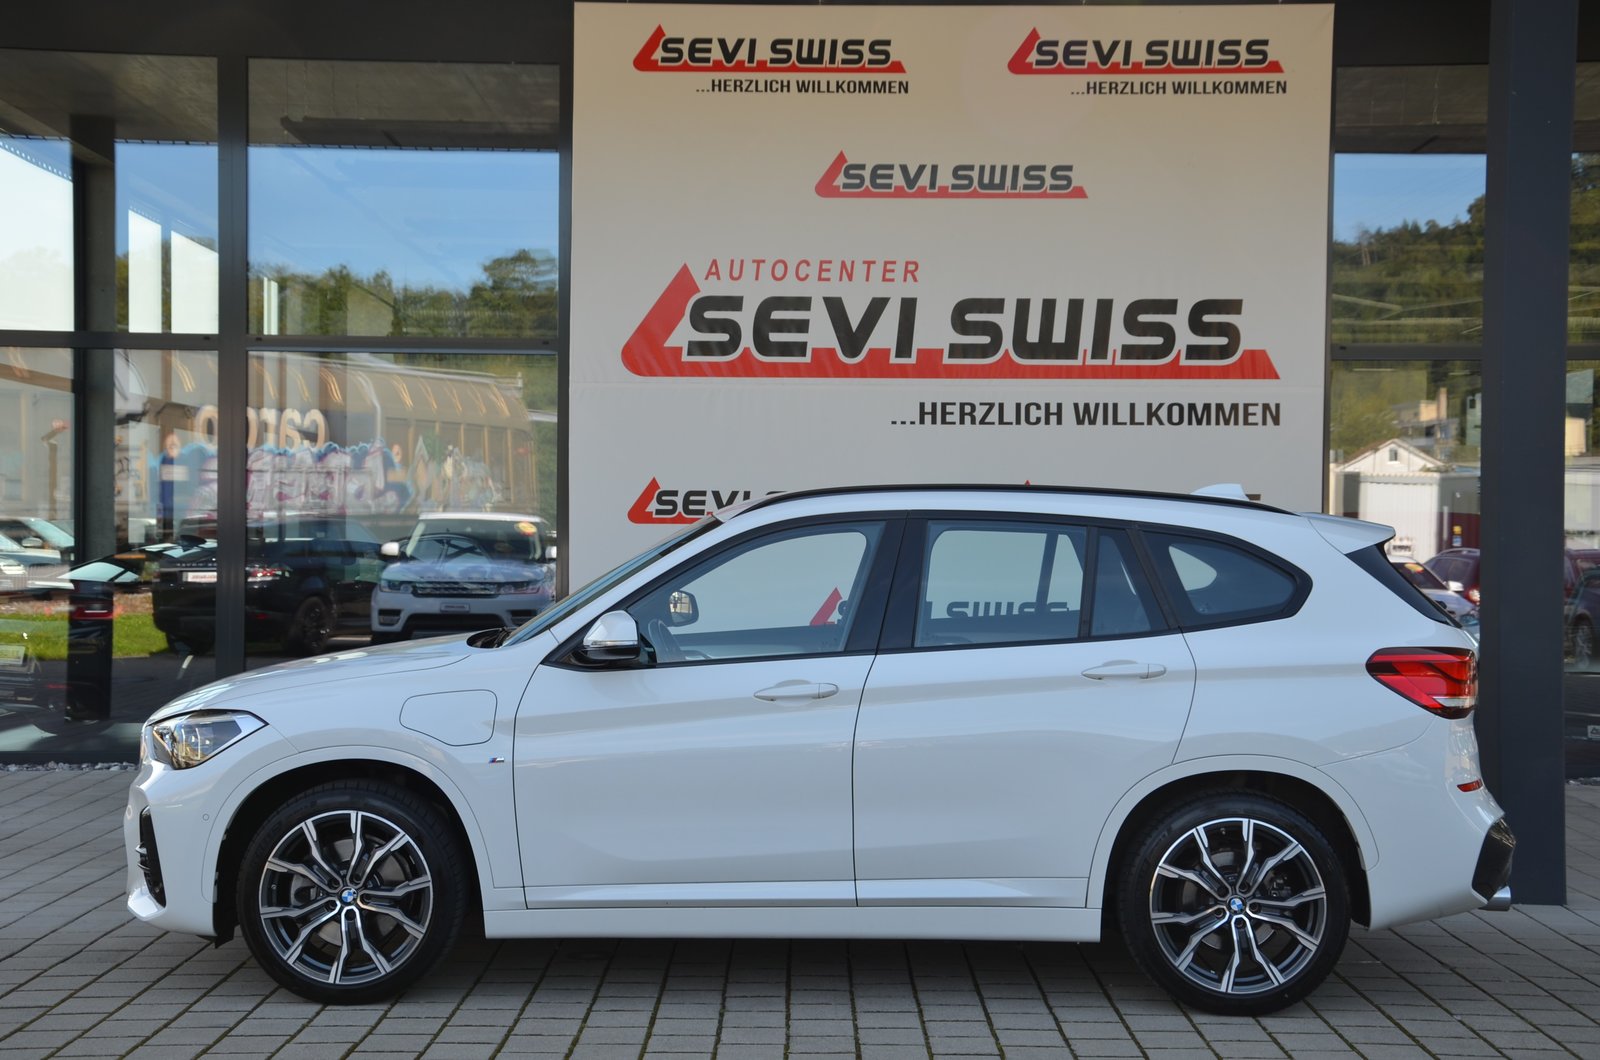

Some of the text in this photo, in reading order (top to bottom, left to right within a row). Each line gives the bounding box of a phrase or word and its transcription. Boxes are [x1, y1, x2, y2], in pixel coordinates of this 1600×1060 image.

[660, 37, 892, 66] SEVI SWISS
[1034, 39, 1270, 67] SEVI SWISS
[795, 79, 909, 94] WILLKOMMEN
[1171, 80, 1287, 95] WILLKOMMEN
[842, 163, 1074, 191] SEVI SWISS
[704, 258, 920, 283] AUTOCENTER
[686, 295, 1244, 361] SEVI SWISS
[1072, 402, 1281, 427] WILLKOMMEN
